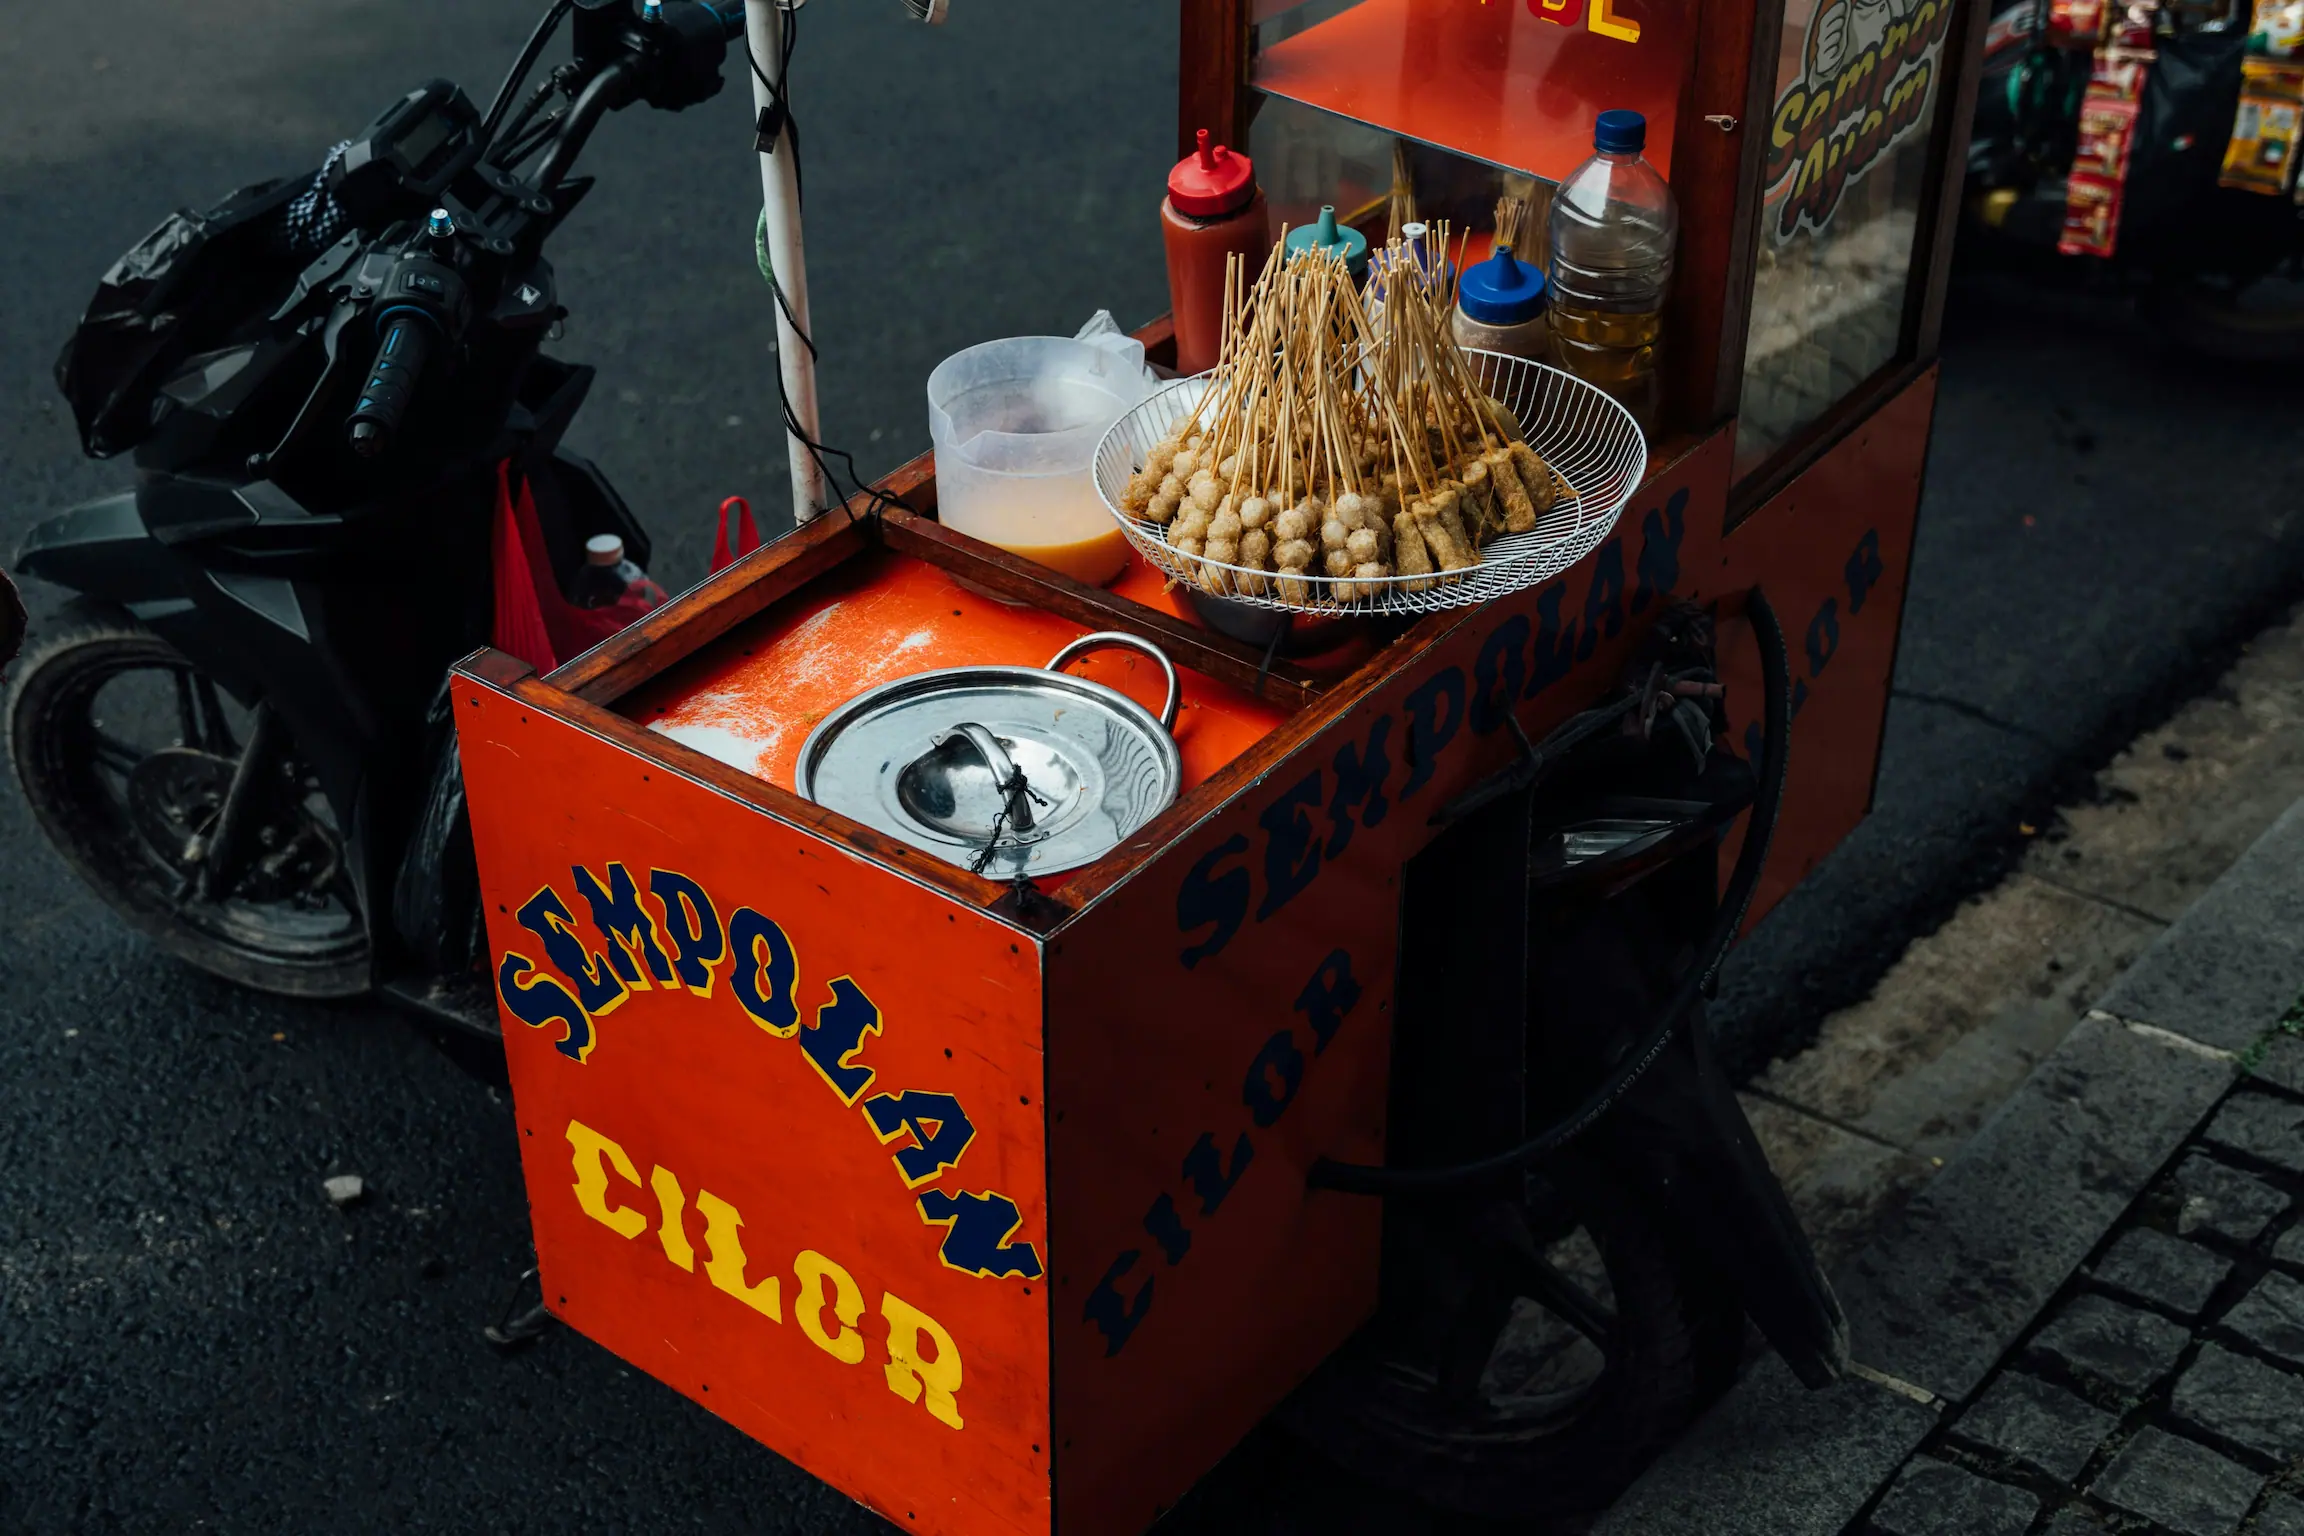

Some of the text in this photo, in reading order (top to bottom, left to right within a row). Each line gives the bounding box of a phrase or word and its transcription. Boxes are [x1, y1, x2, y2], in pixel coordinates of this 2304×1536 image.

[1783, 65, 1931, 236] Ayam
[1177, 487, 1691, 970] SEMPOLAN
[498, 862, 1045, 1280] SEMPOLAN
[565, 1119, 965, 1430] CILOR
[1083, 948, 1362, 1357] CILOR
